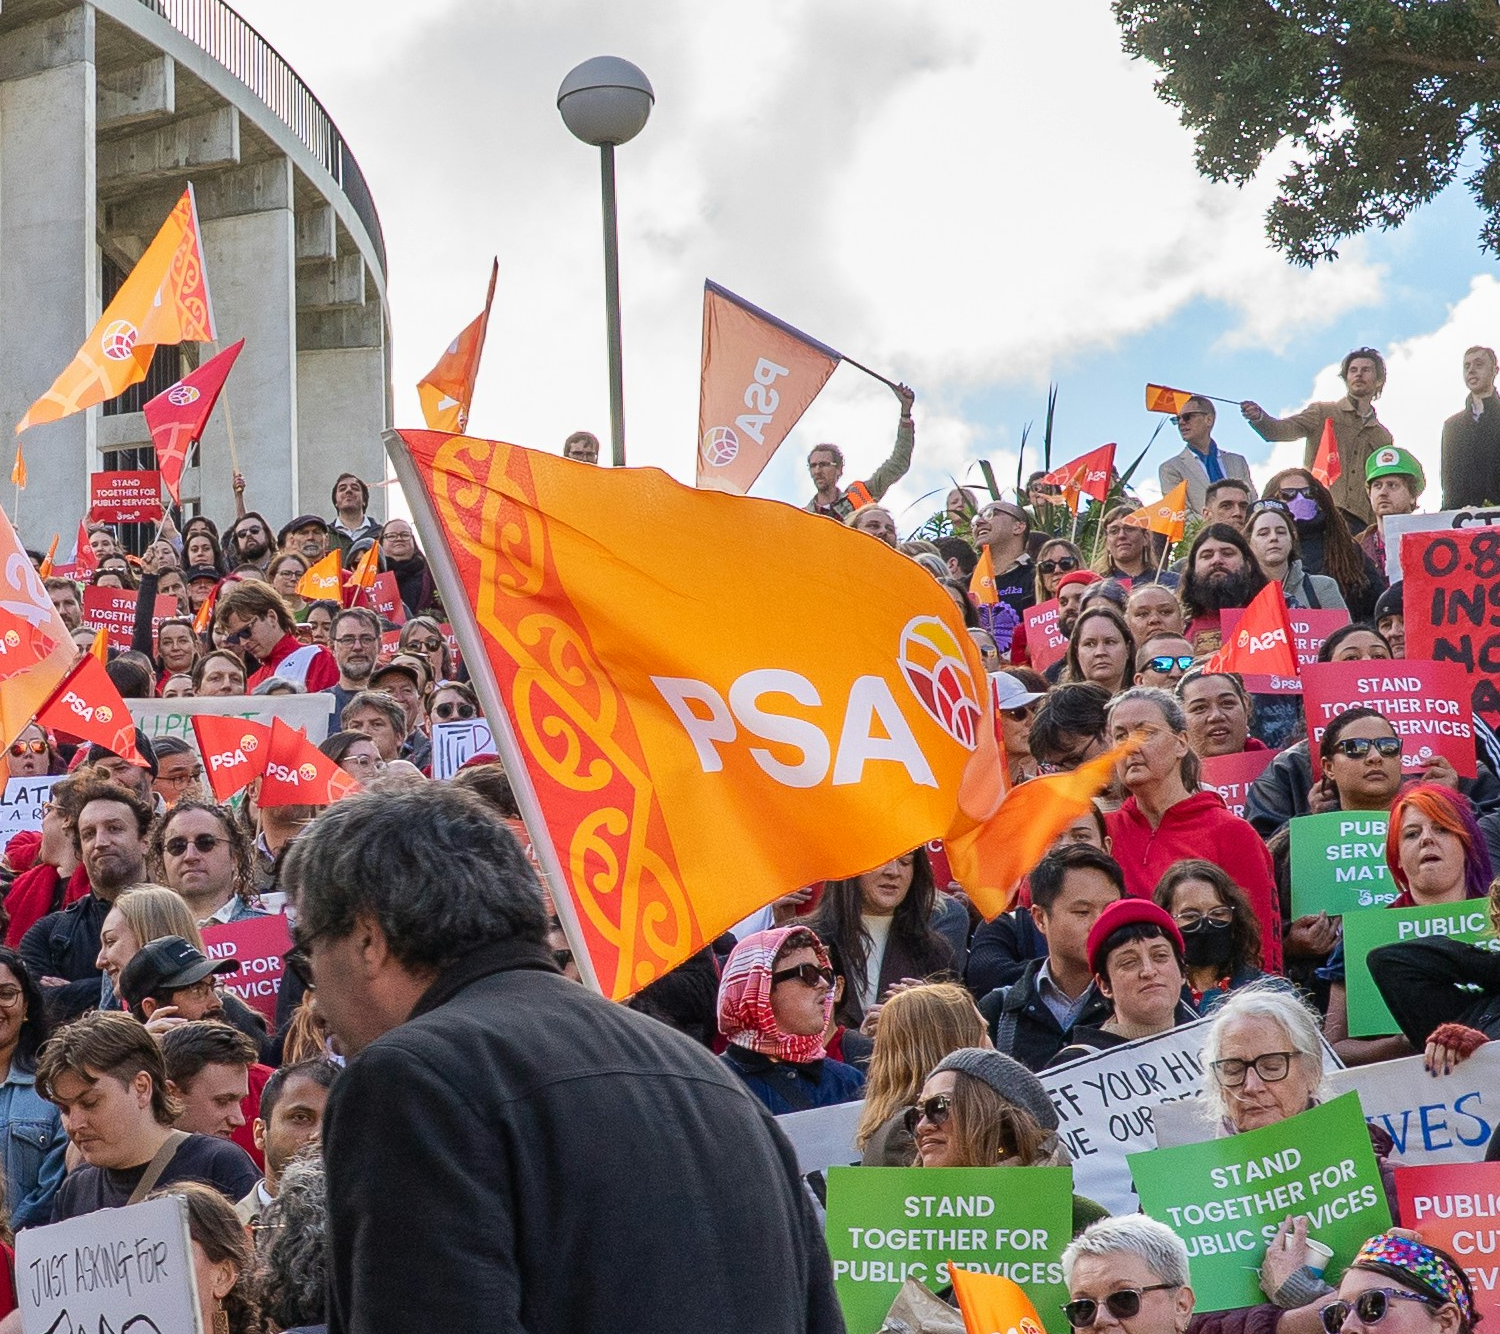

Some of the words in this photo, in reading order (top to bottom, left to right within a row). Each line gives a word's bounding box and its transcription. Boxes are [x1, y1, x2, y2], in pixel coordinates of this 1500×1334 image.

[96, 488, 136, 498] TOGETHER
[139, 488, 156, 496] FOR
[112, 478, 140, 487] STAND
[92, 499, 120, 507] PUBLIC
[122, 498, 159, 506] SERVICES
[91, 609, 135, 622] TOGETHE
[1357, 677, 1421, 693] STAND
[61, 692, 96, 723] PSA
[1426, 699, 1459, 715] FOR
[649, 669, 940, 789] PSA
[210, 749, 248, 770] PSA
[266, 763, 299, 786] PSA
[1341, 821, 1387, 836] PUB
[1326, 843, 1385, 860] SERV
[1335, 867, 1387, 883] MAT
[1398, 912, 1485, 940] PUBLIC
[240, 955, 280, 975] FOR
[1084, 1066, 1159, 1107] YOUR
[1211, 1148, 1301, 1189] STAND
[1167, 1182, 1304, 1227] TOGETHER
[1310, 1159, 1356, 1198] FOR
[904, 1196, 995, 1217] STAND
[848, 1228, 987, 1250] TOGETHER
[996, 1229, 1048, 1250] FOR
[1187, 1229, 1256, 1258] UBLIC
[30, 1253, 67, 1307] JUST
[76, 1241, 132, 1297] ASKING
[136, 1238, 168, 1284] FOR
[833, 1261, 927, 1283] PUBLIC
